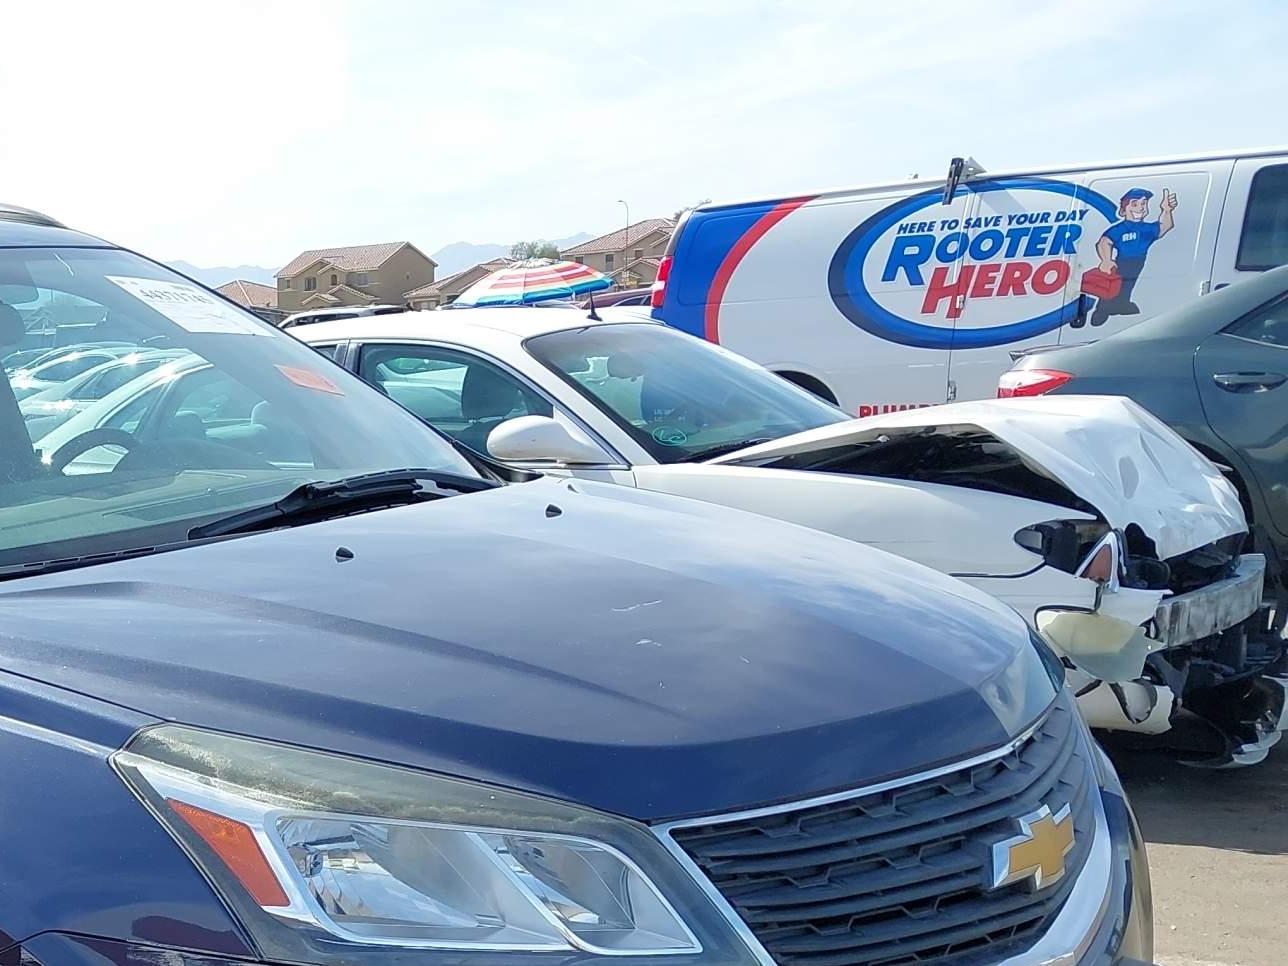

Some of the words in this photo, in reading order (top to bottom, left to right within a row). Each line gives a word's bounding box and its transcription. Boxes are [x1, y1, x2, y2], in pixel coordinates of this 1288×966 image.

[897, 221, 936, 235] HERE
[940, 219, 959, 231] TO
[964, 215, 1002, 229] SAVE
[1007, 211, 1050, 226] YOUR
[1054, 208, 1090, 222] DAY
[1122, 232, 1137, 242] RH
[881, 223, 1082, 286] ROOTER
[920, 259, 1070, 319] HERO
